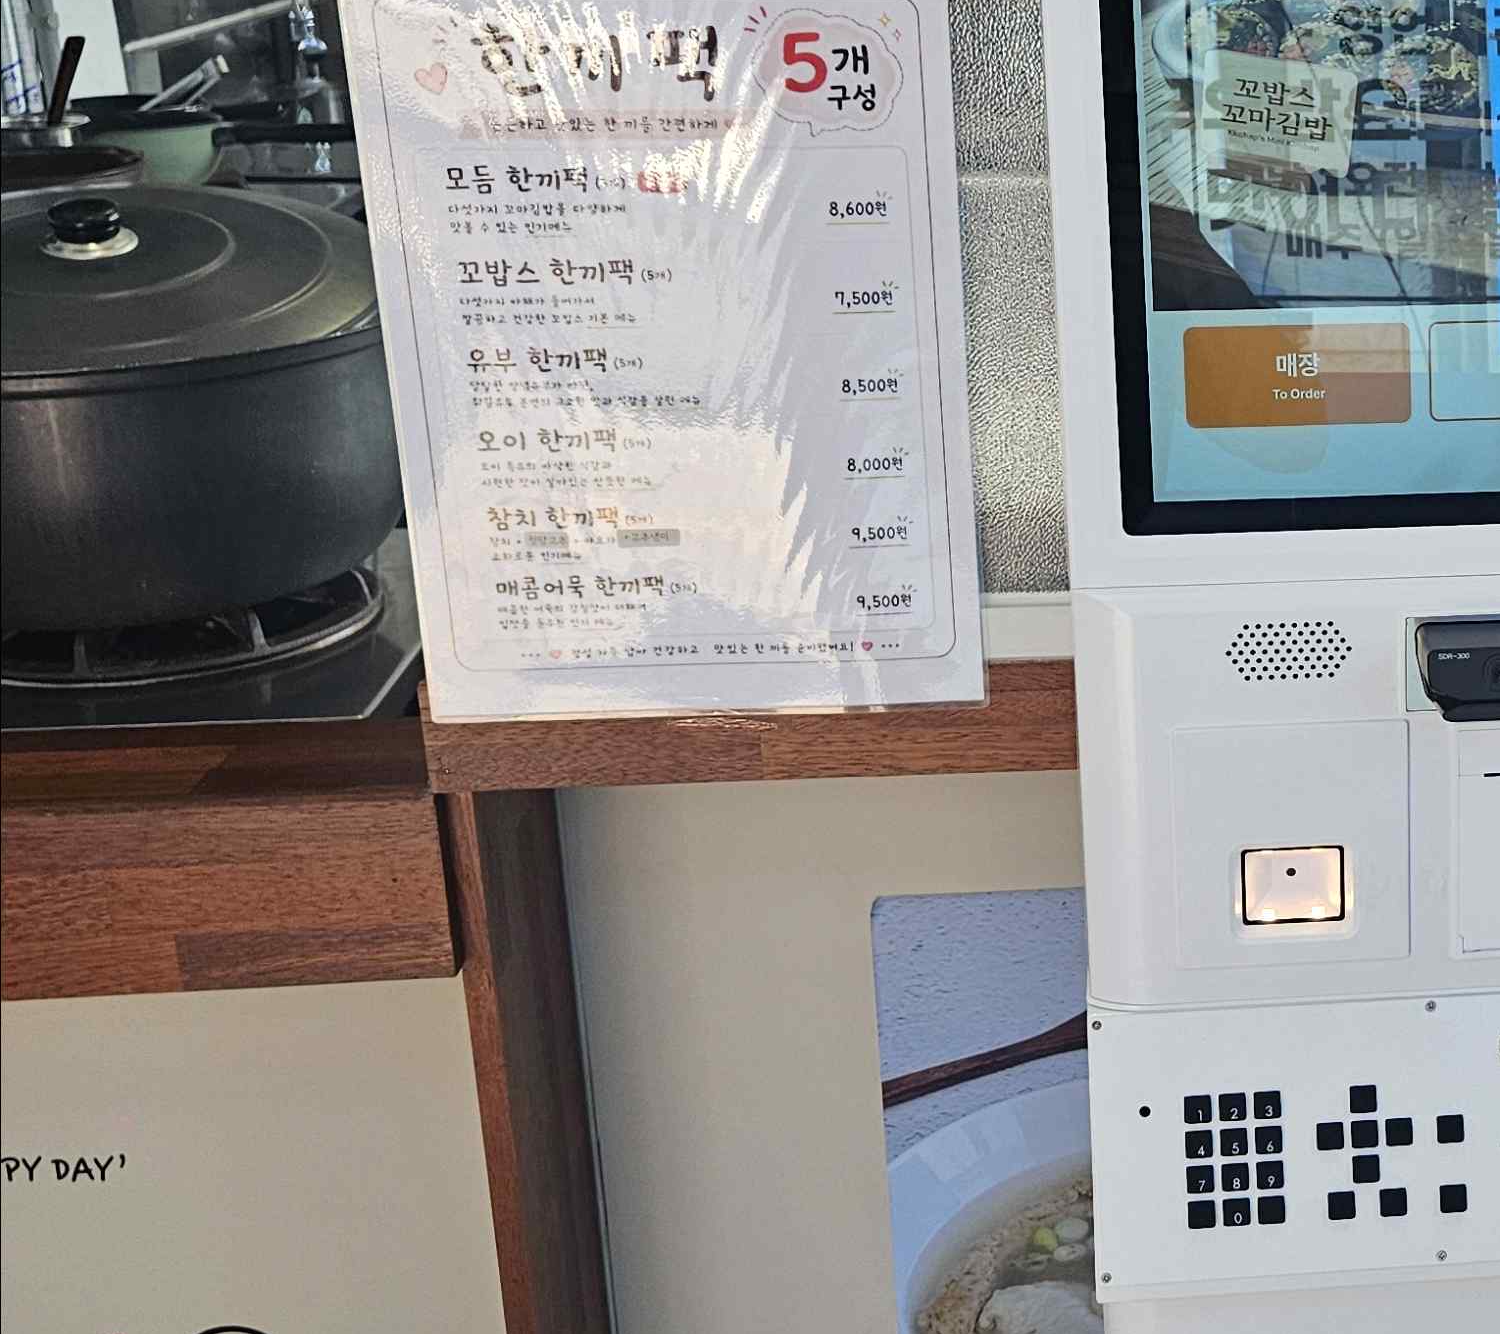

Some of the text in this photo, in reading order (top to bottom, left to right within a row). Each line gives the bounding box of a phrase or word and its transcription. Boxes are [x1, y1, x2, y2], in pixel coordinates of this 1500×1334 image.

[826, 83, 877, 112] 구성
[1233, 78, 1316, 108] 꼬밥스
[1220, 103, 1334, 142] 꼬마김밥
[446, 165, 496, 195] 모듬
[505, 165, 588, 194] 한끼팩
[828, 200, 888, 219] 8,600원
[458, 259, 541, 287] 꼬밥스
[548, 258, 634, 286] 한끼팩
[834, 290, 894, 309] 7,500원
[466, 348, 518, 373] 유부
[526, 346, 608, 373] 한끼팩
[1275, 351, 1321, 378] 매장
[841, 378, 898, 396] 8,500원
[1272, 387, 1327, 400] To Order
[477, 430, 527, 451] 오이
[536, 428, 617, 453] 한끼팩
[847, 456, 904, 474] 8,000원
[486, 506, 537, 532] 참치
[544, 506, 619, 530] 한끼팩
[851, 525, 907, 543] 9,500원
[495, 574, 586, 601] 매콤어묵
[593, 574, 665, 598] 한끼팩
[856, 593, 912, 612] 9,500원
[1197, 1105, 1273, 1122] 1 2 3
[1197, 1140, 1274, 1156] 4 5 6
[1, 1155, 42, 1183] PY
[1198, 1175, 1275, 1191] 7 8 9
[1233, 1212, 1243, 1224] 0
